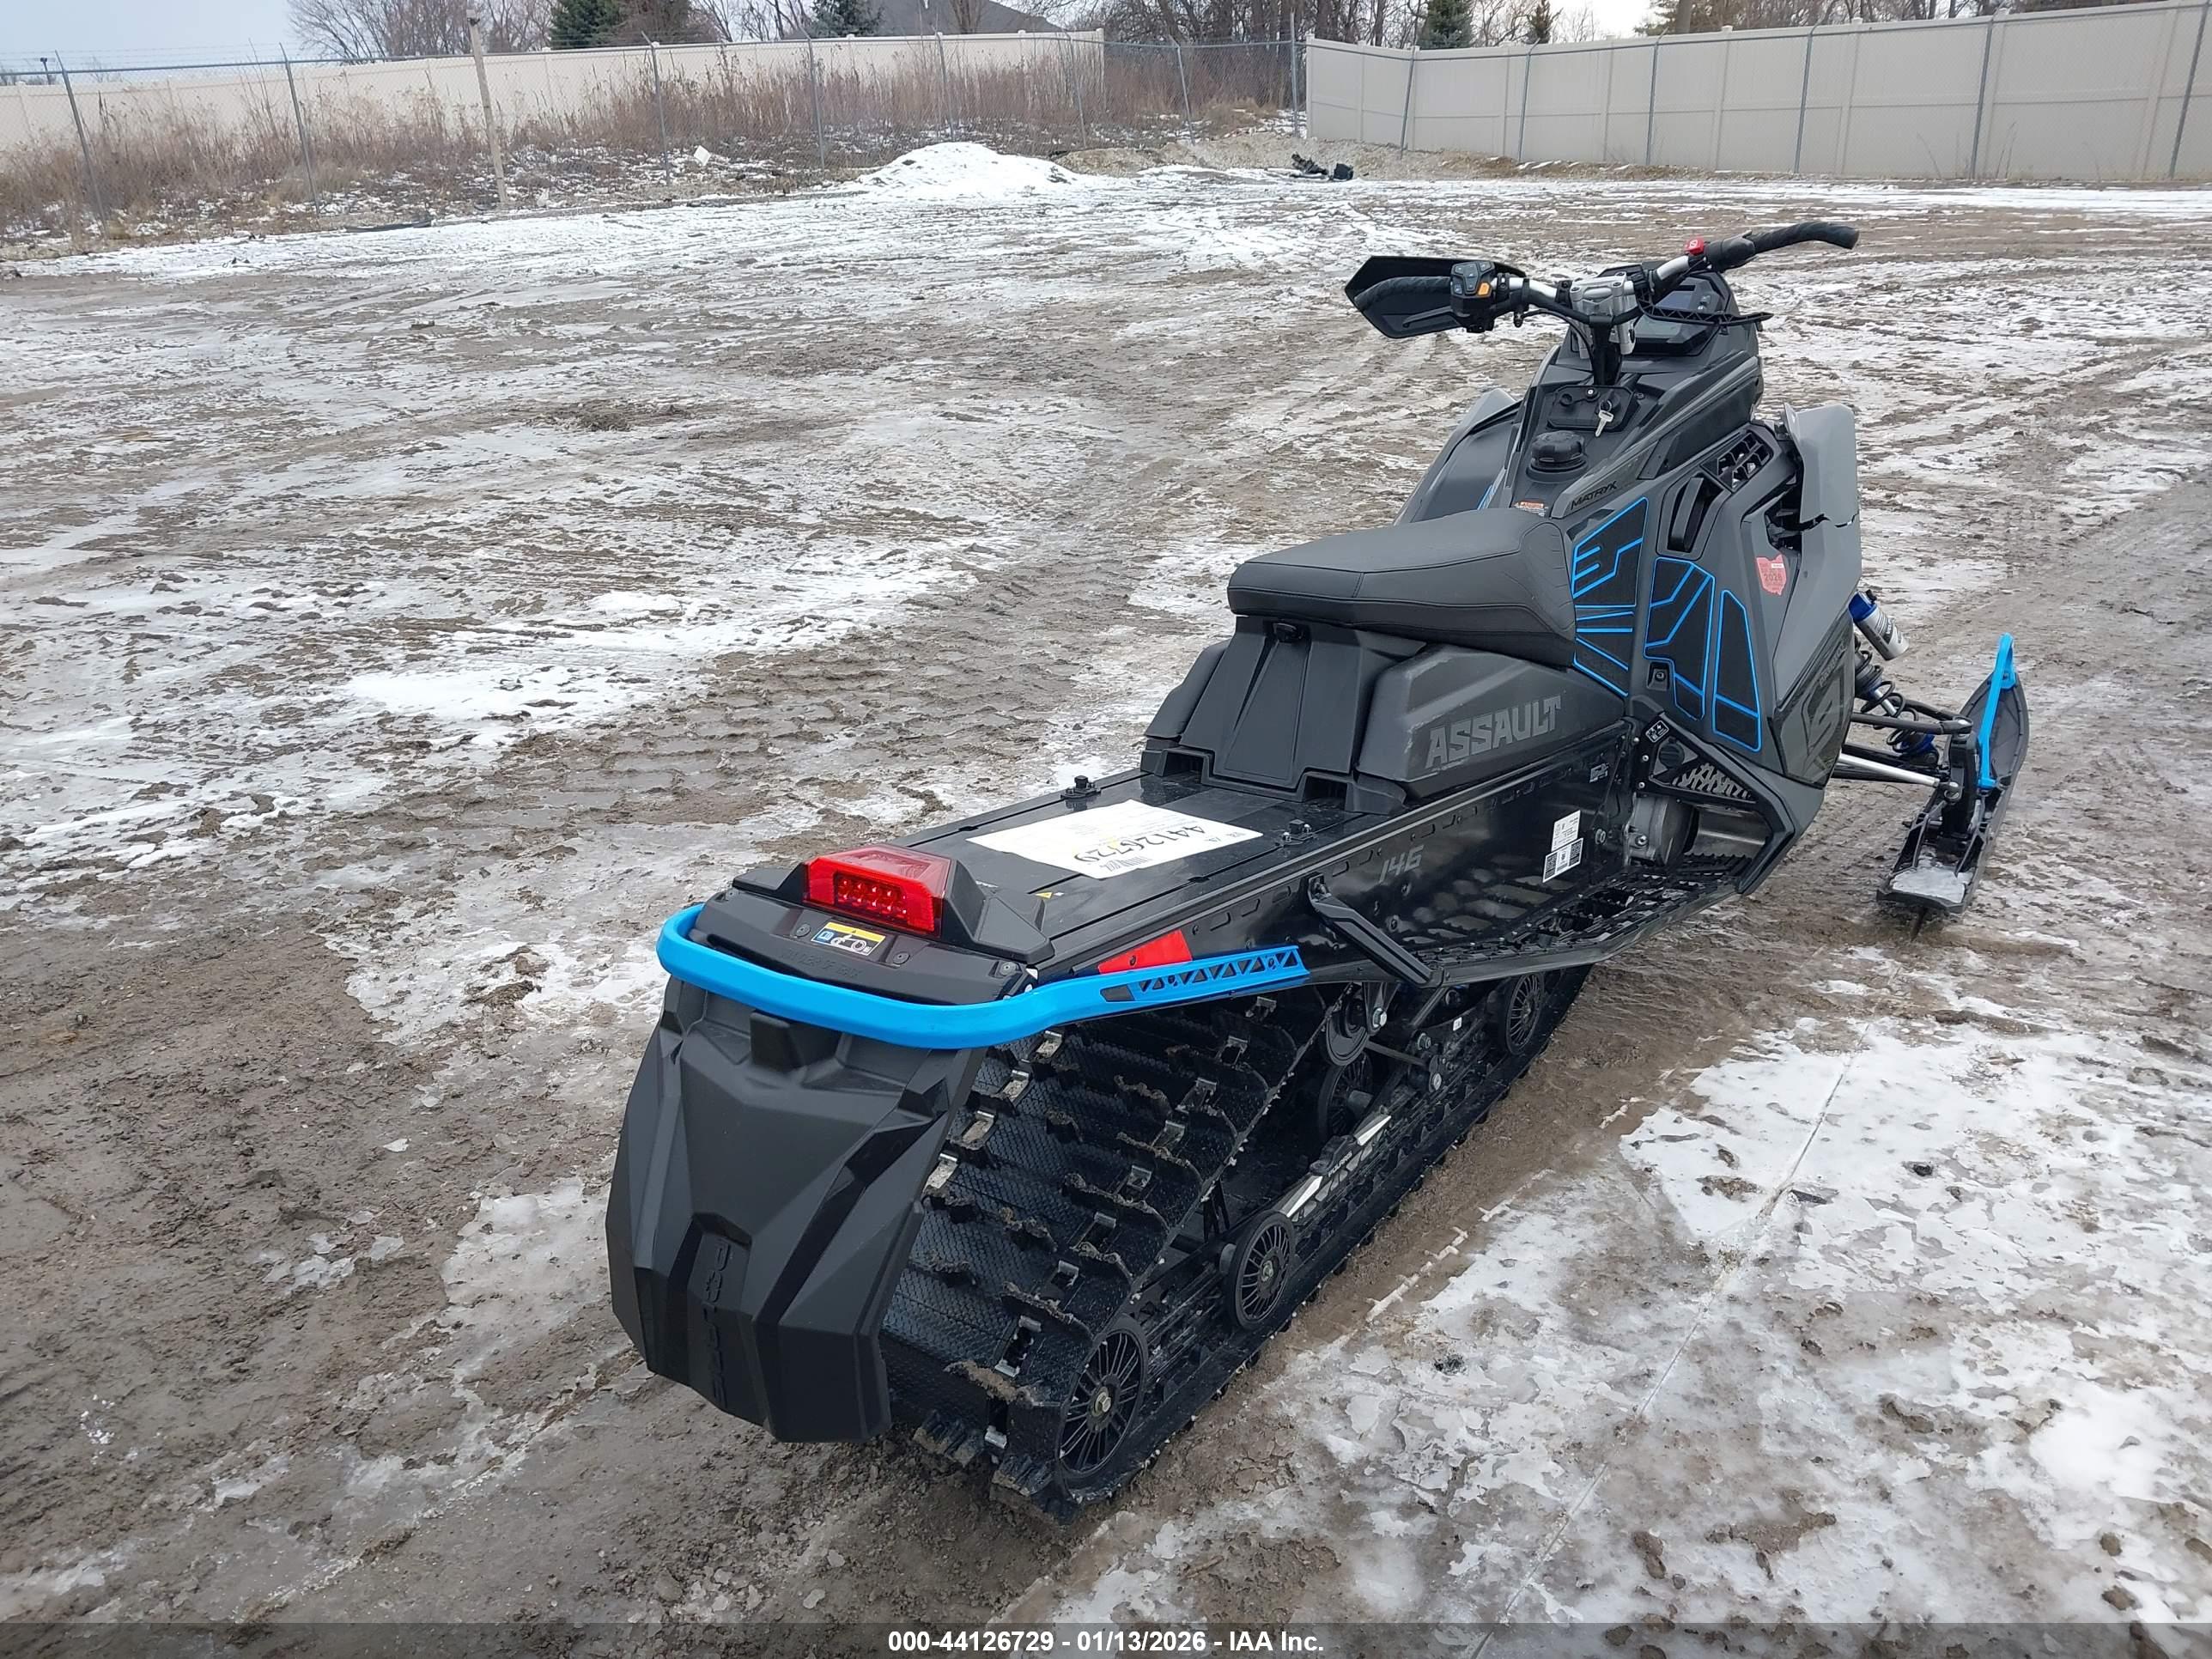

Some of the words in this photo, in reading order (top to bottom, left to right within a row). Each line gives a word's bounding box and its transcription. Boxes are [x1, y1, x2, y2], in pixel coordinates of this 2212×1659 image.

[1571, 480, 1618, 511] MATRYX
[1425, 695, 1562, 769] ASSAULT
[1073, 824, 1206, 863] 44126729
[1378, 844, 1425, 884] 146
